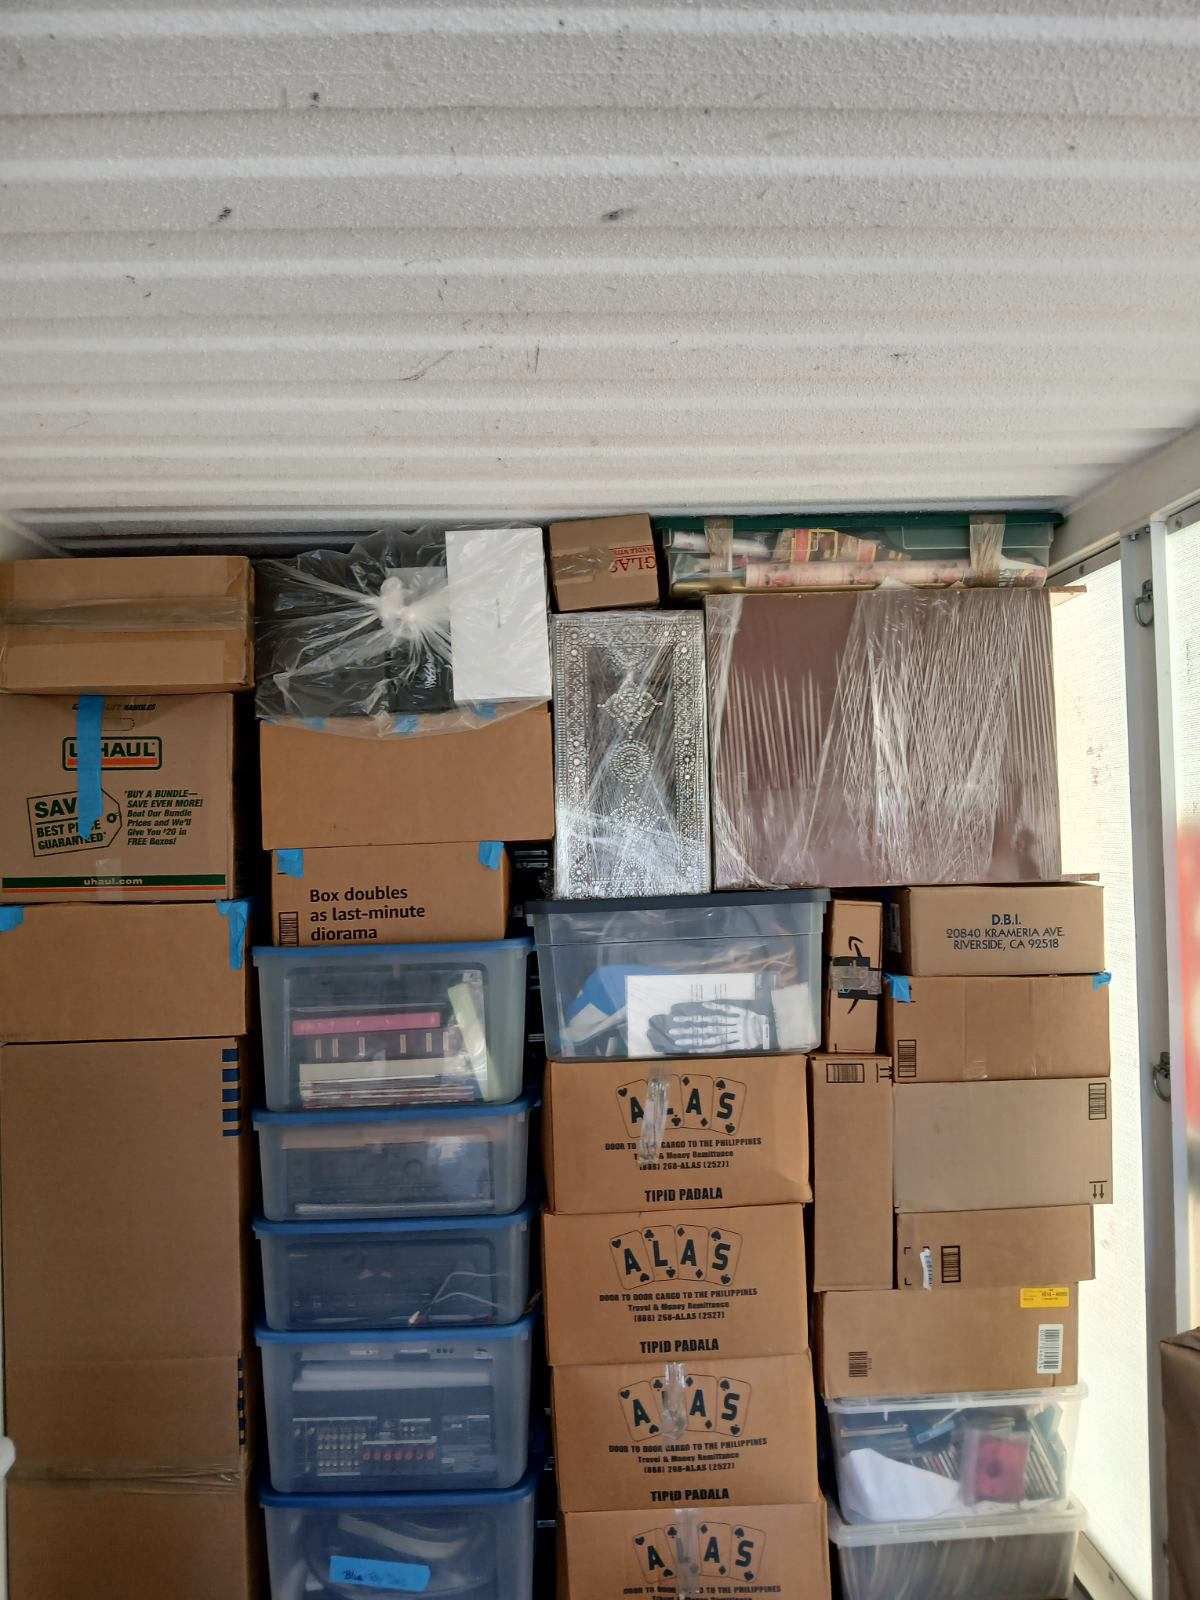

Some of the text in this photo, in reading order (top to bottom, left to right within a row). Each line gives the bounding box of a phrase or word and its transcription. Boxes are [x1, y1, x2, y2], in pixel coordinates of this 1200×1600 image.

[146, 790, 152, 798] A
[127, 799, 203, 808] SAVE EVEN MORE!
[147, 809, 162, 817] Our
[127, 819, 151, 827] Prices
[37, 824, 64, 838] BEST
[127, 828, 144, 836] Give
[179, 827, 187, 835] in
[149, 837, 177, 845] Boxes!
[83, 877, 143, 886] uhaul.com
[310, 886, 408, 902] Box doubles
[310, 905, 425, 922] as last-minute
[991, 913, 1022, 925] D.B.I.
[311, 926, 377, 941] diorama
[946, 926, 1065, 938] 20840 KRAMERIA AVE.
[953, 938, 1059, 951] RIVERSIDE, CA 92518
[688, 1140, 697, 1148] TO
[715, 1138, 762, 1147] PHILIPPINES
[666, 1152, 690, 1160] Money
[645, 1187, 723, 1202] TIPID PADALA
[624, 1239, 731, 1275] ALAS
[622, 1293, 631, 1301] TO
[633, 1293, 653, 1301] DOOR
[656, 1292, 680, 1300] CARGO
[683, 1291, 692, 1299] TO
[710, 1288, 758, 1297] PHILIPPINES
[661, 1303, 685, 1311] Money
[640, 1338, 719, 1354] TIPID PADALA
[705, 1442, 718, 1450] THE
[720, 1438, 768, 1449] PHILIPPINES
[671, 1455, 695, 1463] Money
[650, 1488, 729, 1502] TIPID PADALA
[734, 1585, 782, 1593] PHILIPPINES
